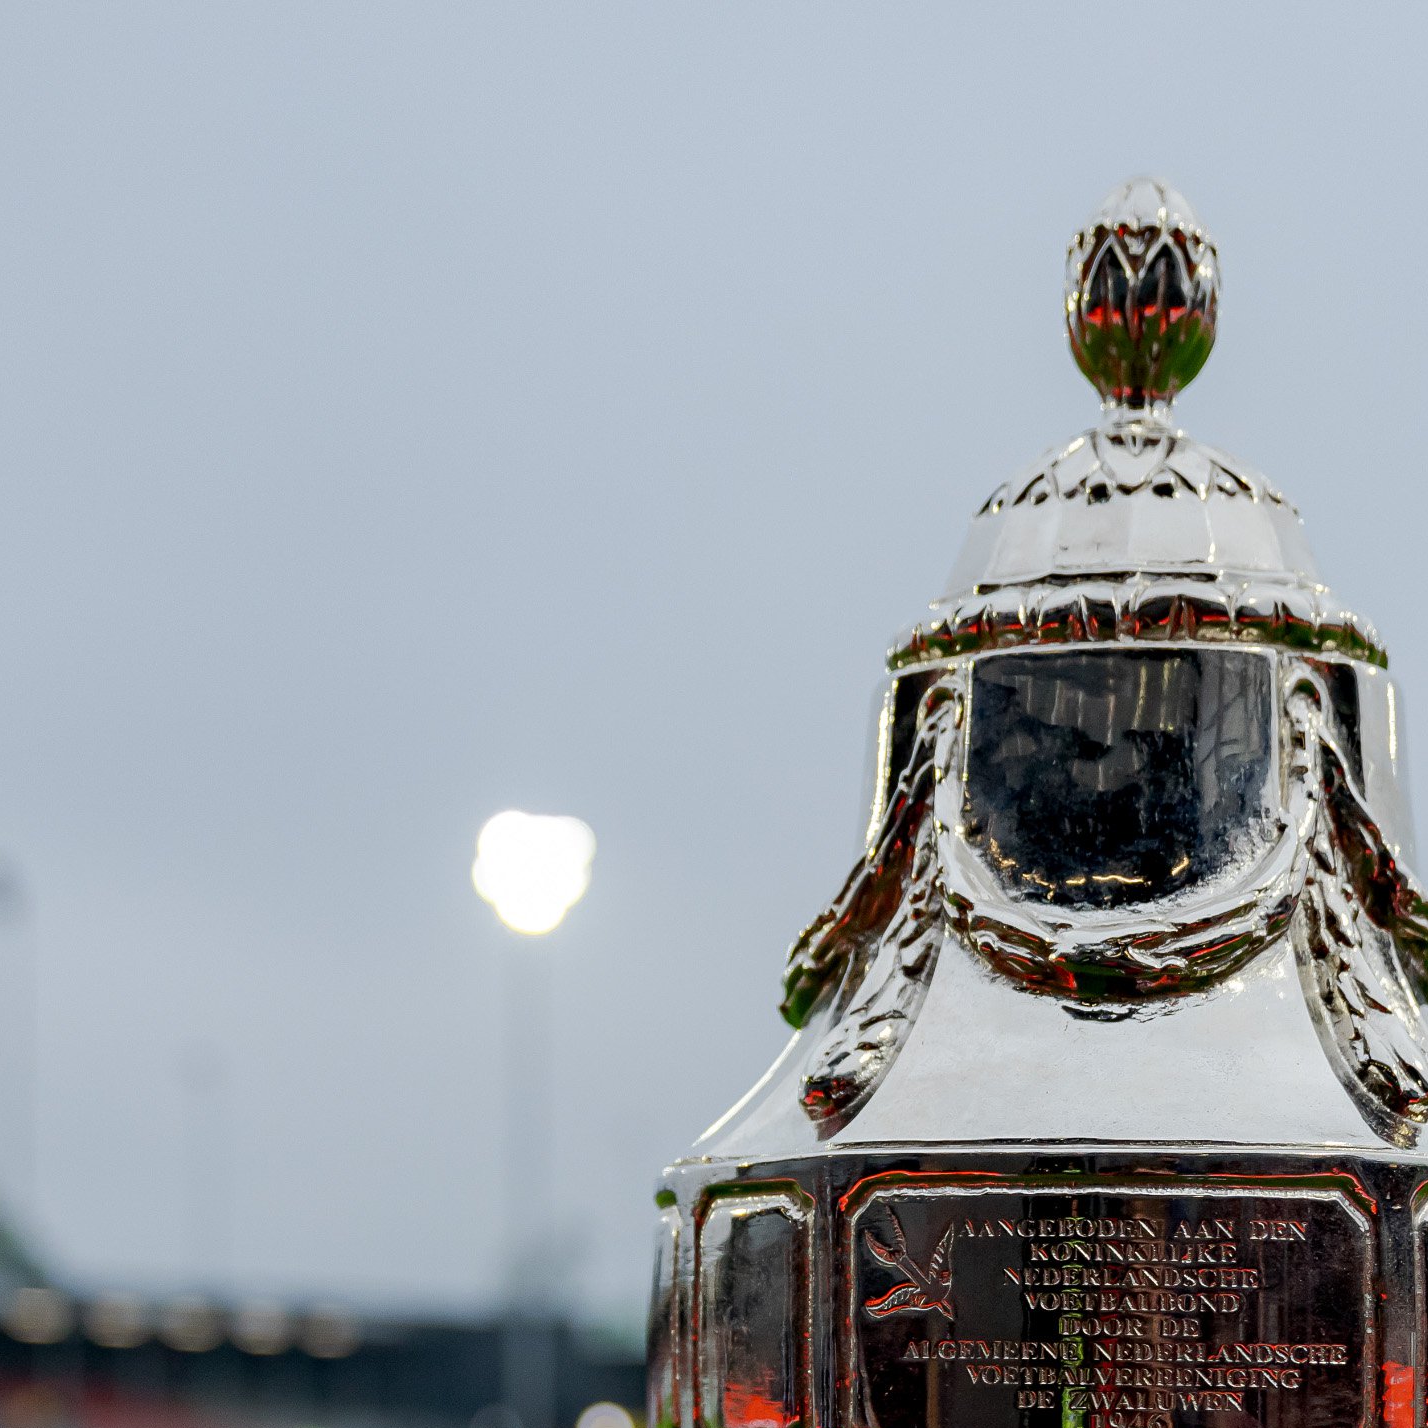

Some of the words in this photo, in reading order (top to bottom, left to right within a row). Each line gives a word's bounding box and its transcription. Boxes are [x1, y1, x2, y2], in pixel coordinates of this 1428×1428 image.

[958, 1218, 1162, 1238] AANGEBODEN
[1174, 1219, 1235, 1239] AAN
[1249, 1220, 1309, 1241] DEN
[1030, 1241, 1238, 1264] KONINKLIJKE
[1003, 1266, 1260, 1288] NEDERLANDSCHE
[1024, 1291, 1243, 1313] VOETBALBOND
[1061, 1317, 1144, 1336] DOOR
[1161, 1319, 1200, 1337] DE
[903, 1339, 1079, 1360] ALGEMEENE
[1093, 1341, 1349, 1365] NEDERLANDSCHE
[966, 1365, 1303, 1389] VOETBALVEREENIGING
[1016, 1391, 1055, 1409] DE
[1069, 1391, 1245, 1411] ZWALUWEN
